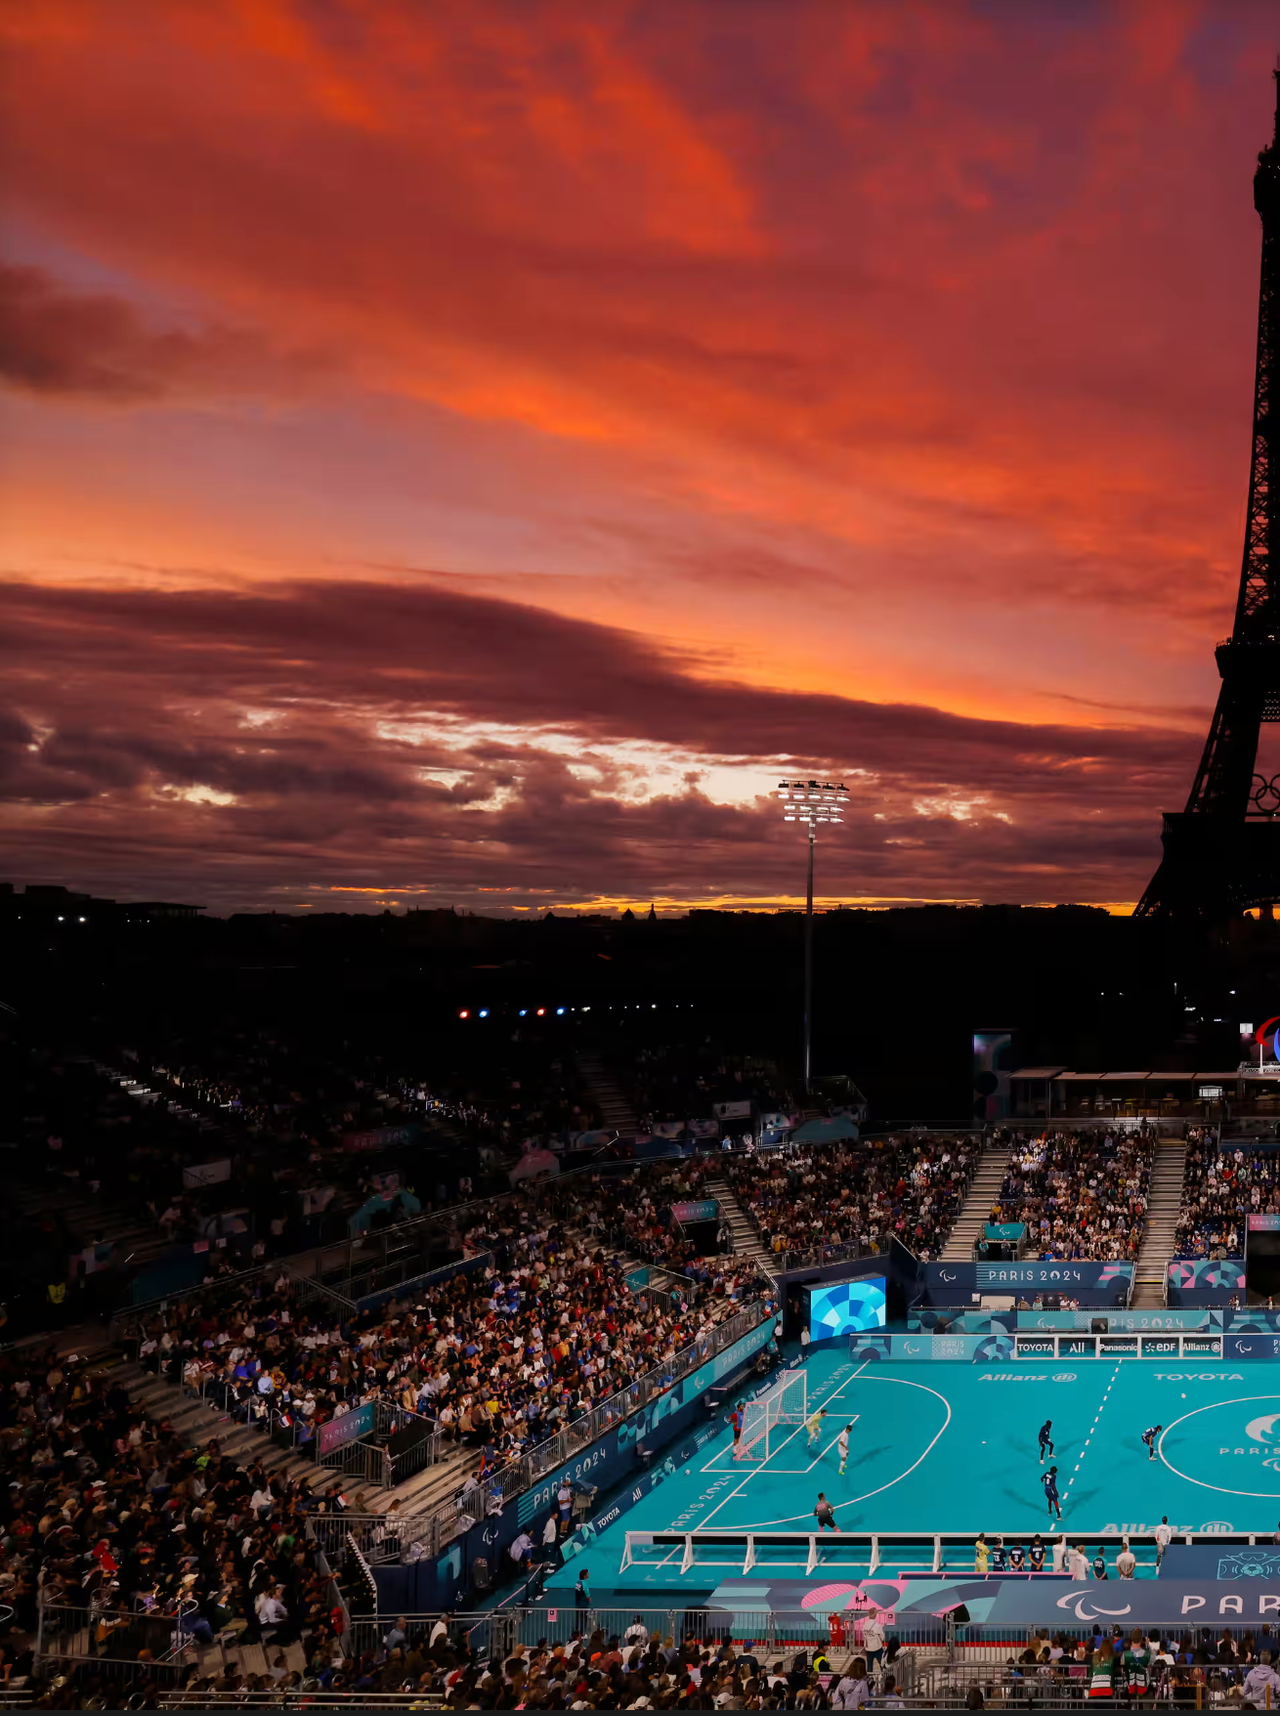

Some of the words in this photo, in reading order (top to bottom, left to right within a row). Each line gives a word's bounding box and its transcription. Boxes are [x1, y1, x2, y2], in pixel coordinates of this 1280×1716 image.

[1040, 1270, 1081, 1281] 2024
[1141, 1317, 1184, 1328] 2024
[1017, 1343, 1053, 1351] TOYOTA
[1099, 1343, 1138, 1351] Panasonic
[1183, 1342, 1209, 1351] Allianz
[978, 1372, 1048, 1382] Allianz
[1153, 1373, 1244, 1381] TOYOTA
[575, 1447, 606, 1478] 2024
[698, 1475, 735, 1500] 2024
[597, 1506, 620, 1528] TOYOTA
